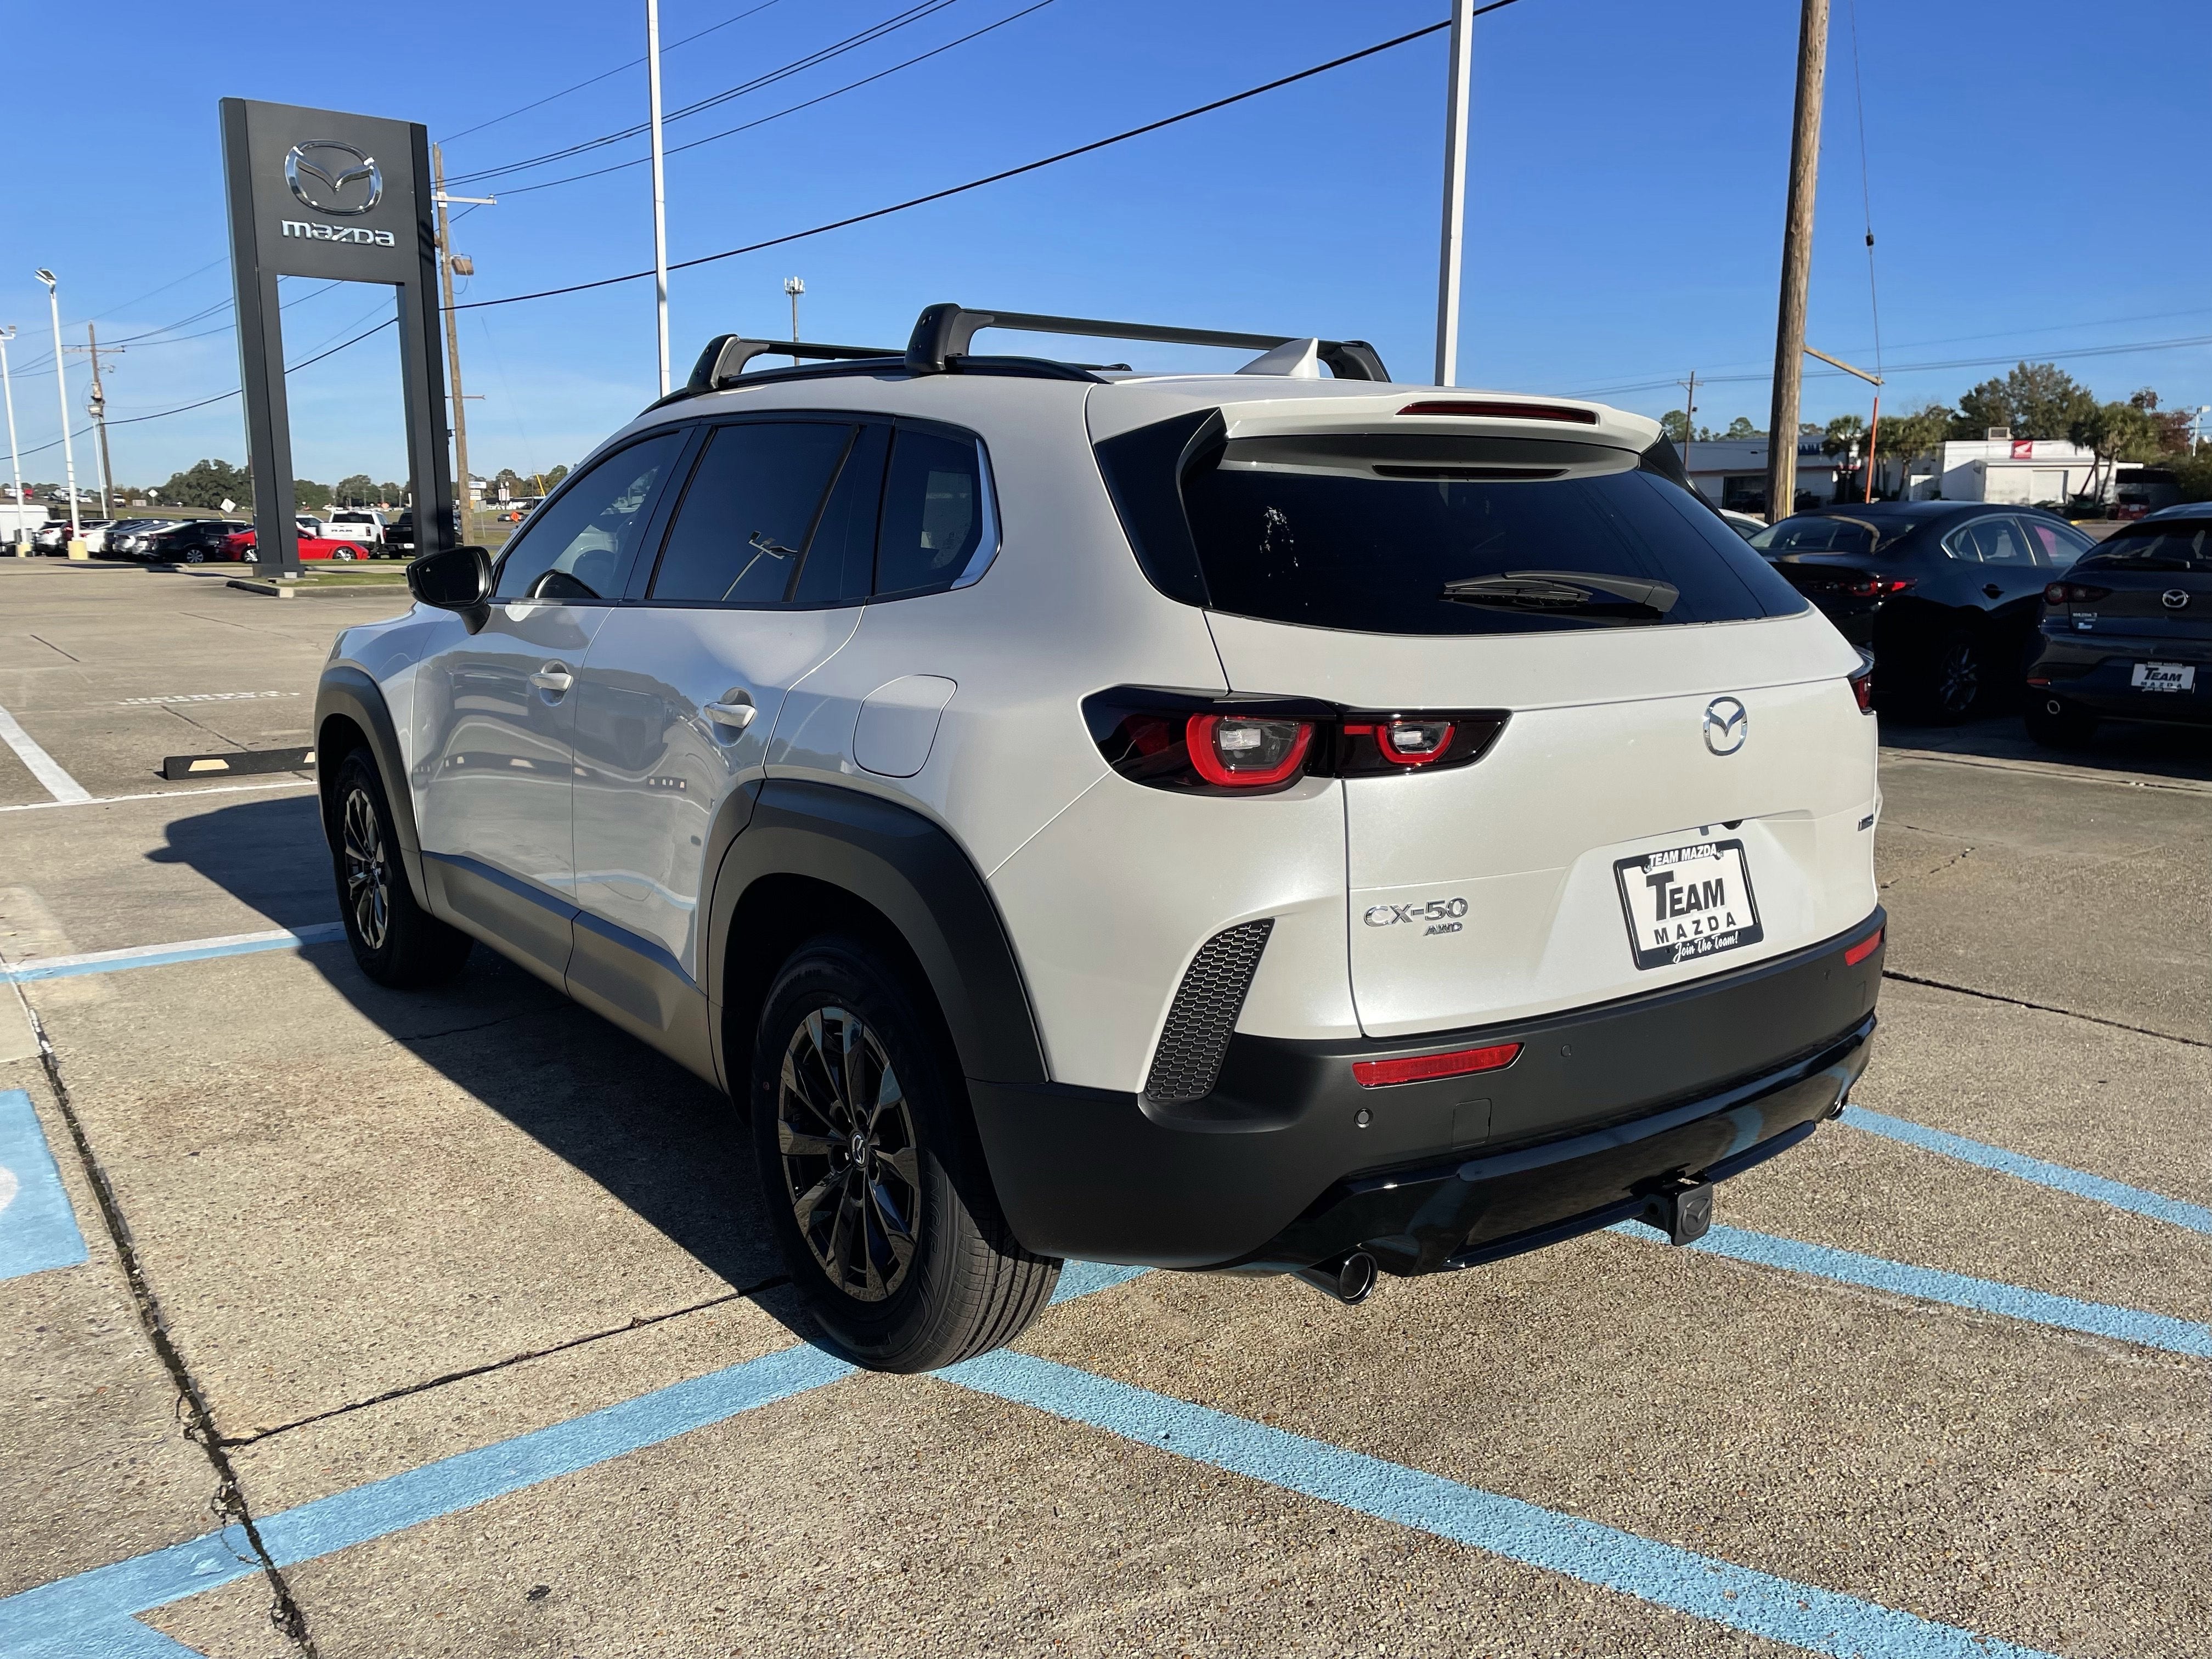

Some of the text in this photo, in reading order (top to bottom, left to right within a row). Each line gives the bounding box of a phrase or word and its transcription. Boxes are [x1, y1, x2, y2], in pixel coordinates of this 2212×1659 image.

[2144, 667, 2182, 681] TEAM
[1649, 844, 1718, 867] TEAM MAZDA
[1646, 870, 1725, 921] TEAM
[1364, 897, 1469, 927] CX-50
[1423, 922, 1463, 936] AWD
[1654, 912, 1736, 945] MAZDA
[1673, 930, 1739, 963] Join The Team!
